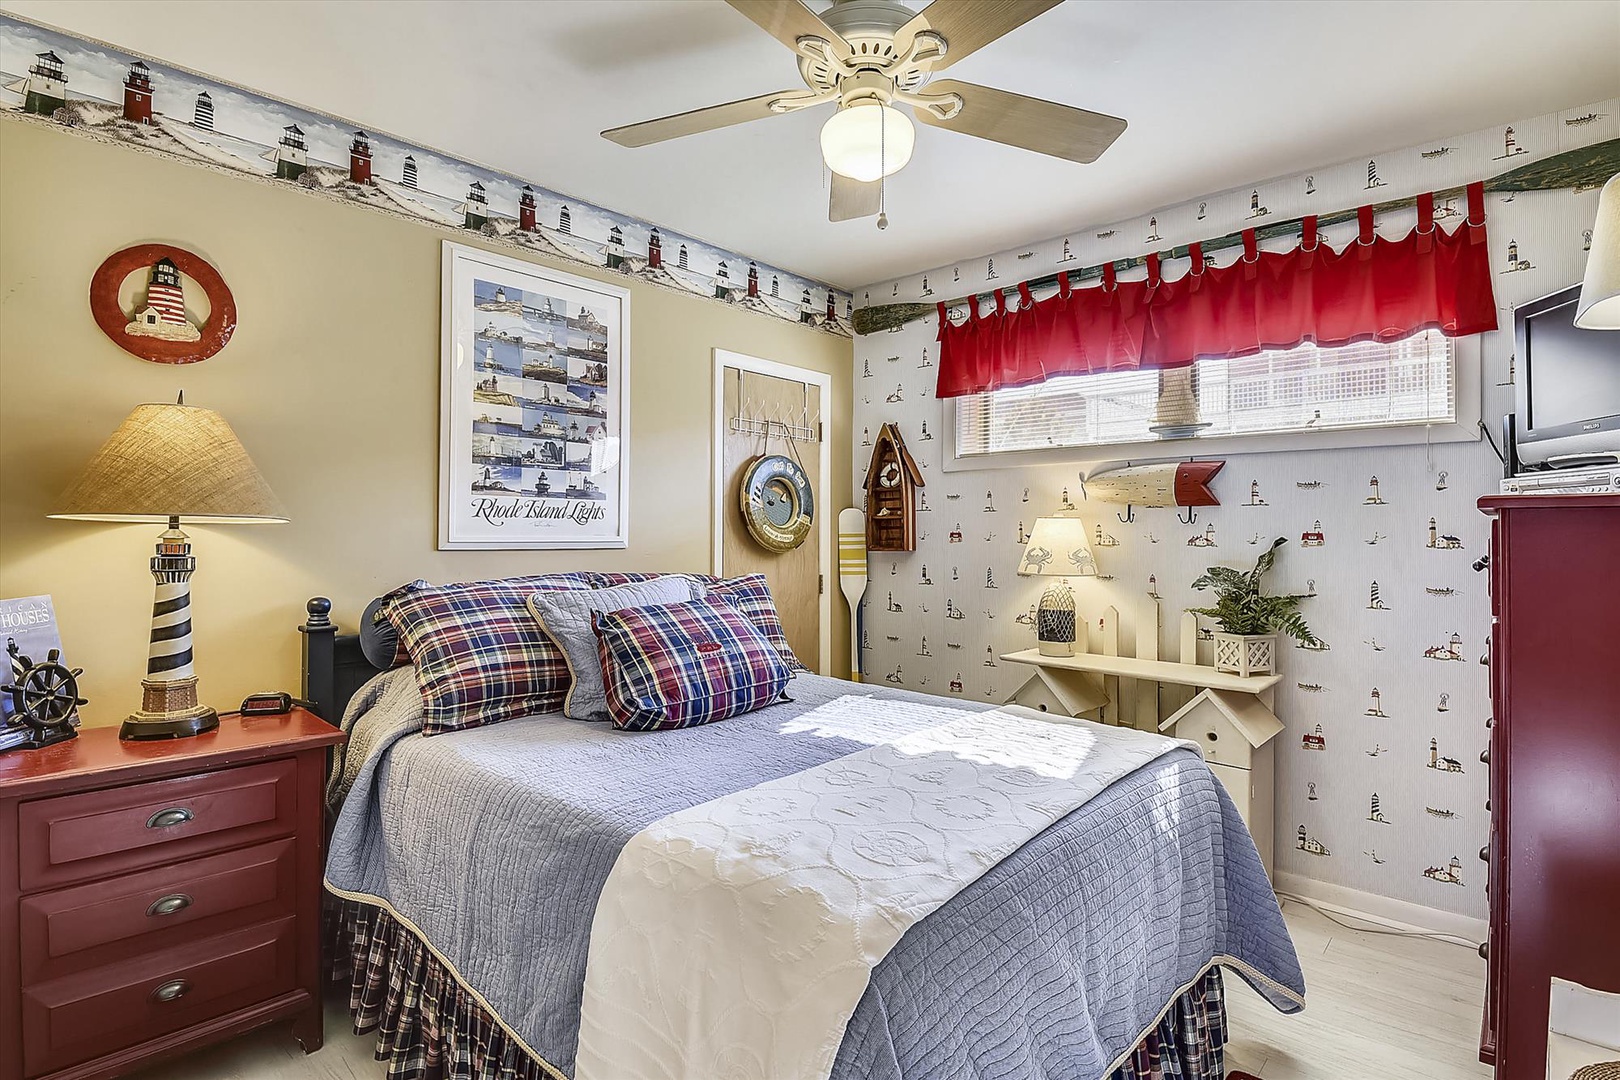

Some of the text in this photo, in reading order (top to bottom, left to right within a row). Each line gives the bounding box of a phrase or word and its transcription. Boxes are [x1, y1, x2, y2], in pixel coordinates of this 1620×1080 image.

[471, 498, 606, 526] Rhode Island Lights
[1, 608, 50, 628] HOUSES
